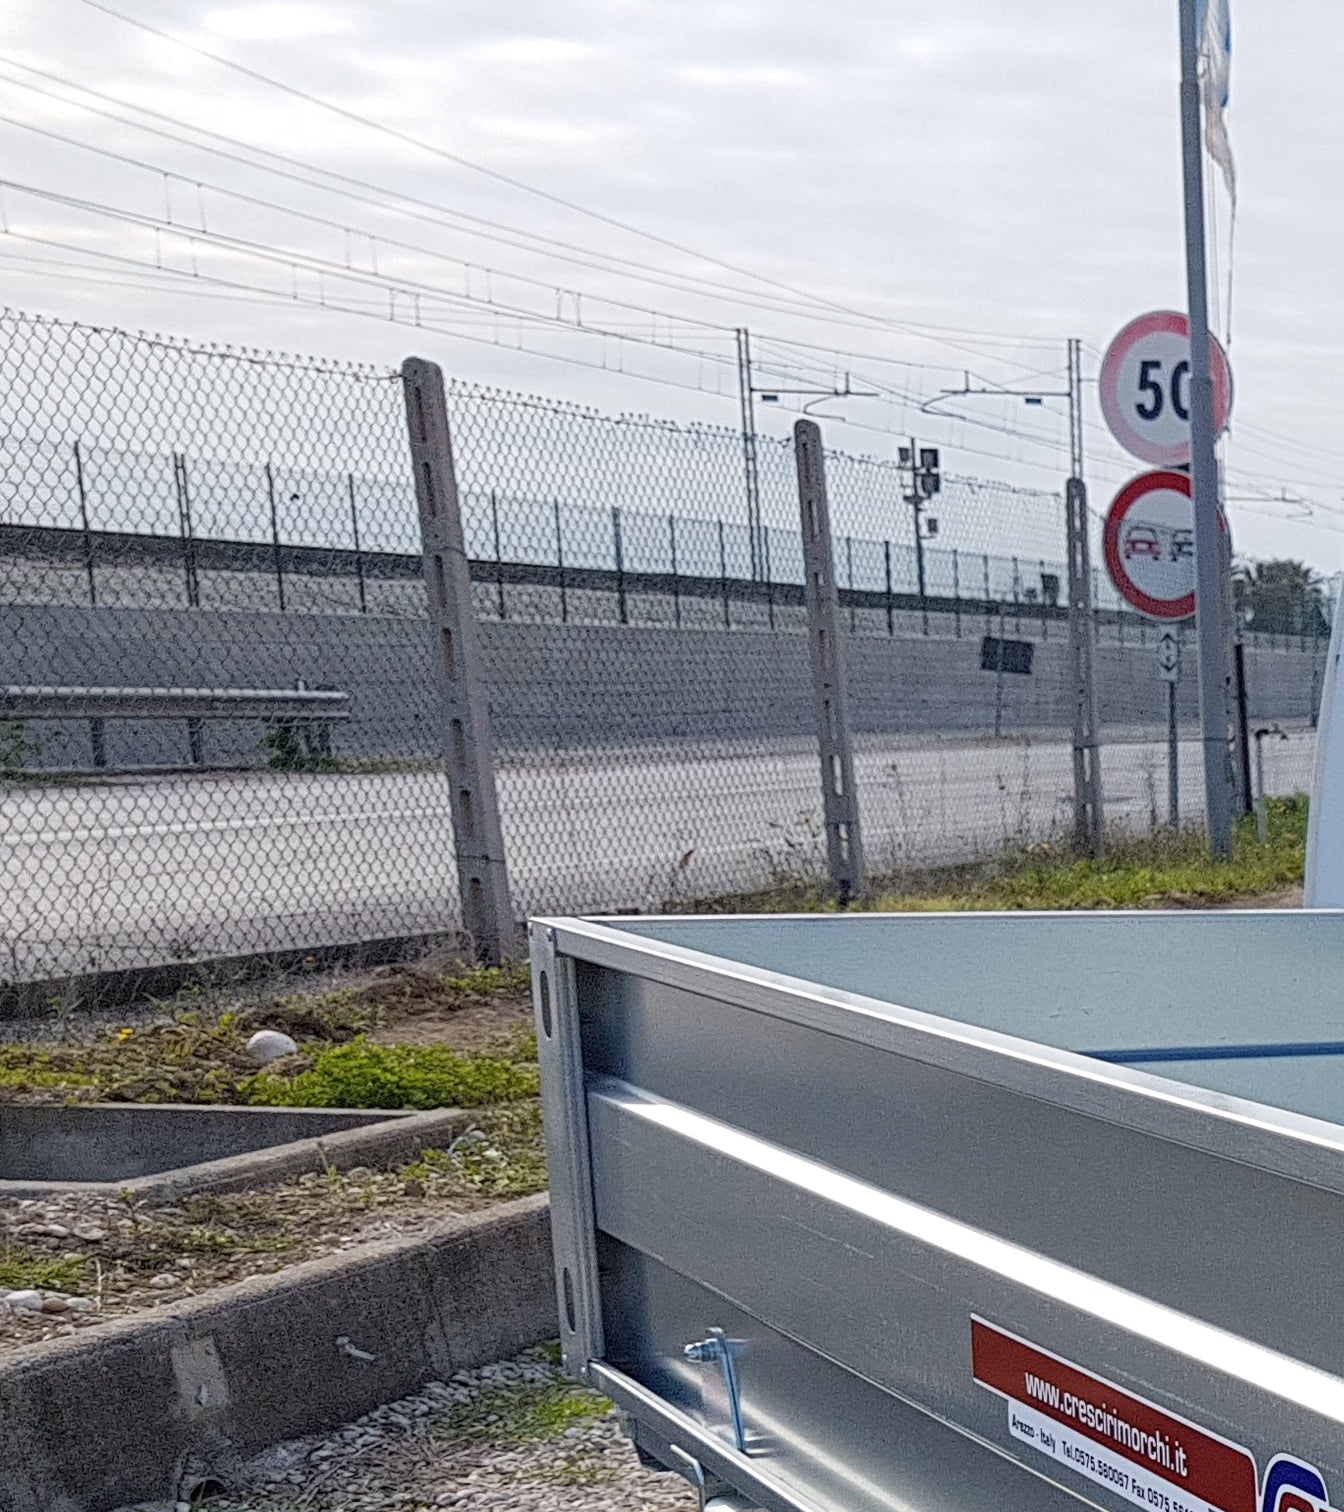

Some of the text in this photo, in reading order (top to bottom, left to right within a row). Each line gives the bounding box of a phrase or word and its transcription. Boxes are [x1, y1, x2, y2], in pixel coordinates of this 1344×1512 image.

[1136, 361, 1188, 420] 50
[1025, 1372, 1188, 1478] www.crescirimorchi.it
[1131, 1478, 1146, 1501] Fax
